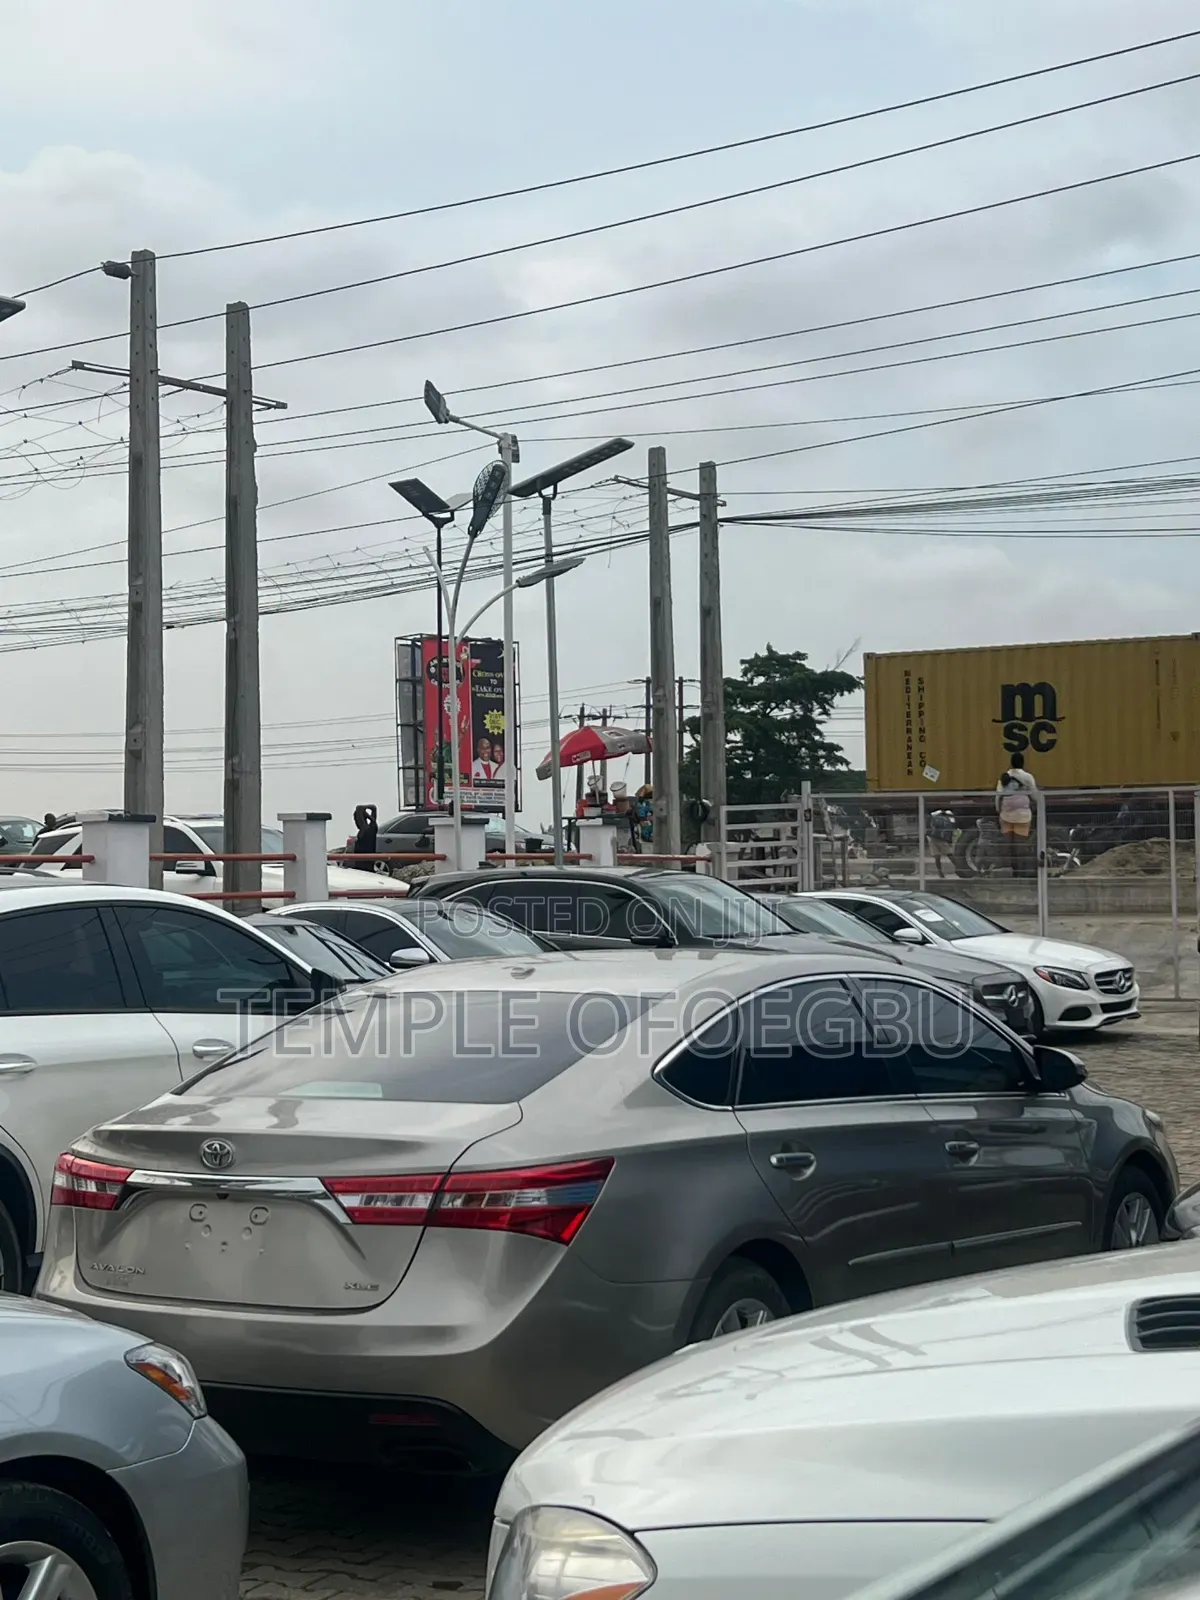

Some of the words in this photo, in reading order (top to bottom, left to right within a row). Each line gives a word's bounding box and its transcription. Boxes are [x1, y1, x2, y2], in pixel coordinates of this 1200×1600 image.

[475, 684, 493, 693] TAKE
[917, 677, 926, 743] SHIPPING
[90, 1262, 146, 1275] AVALON
[343, 1281, 380, 1291] XLE
